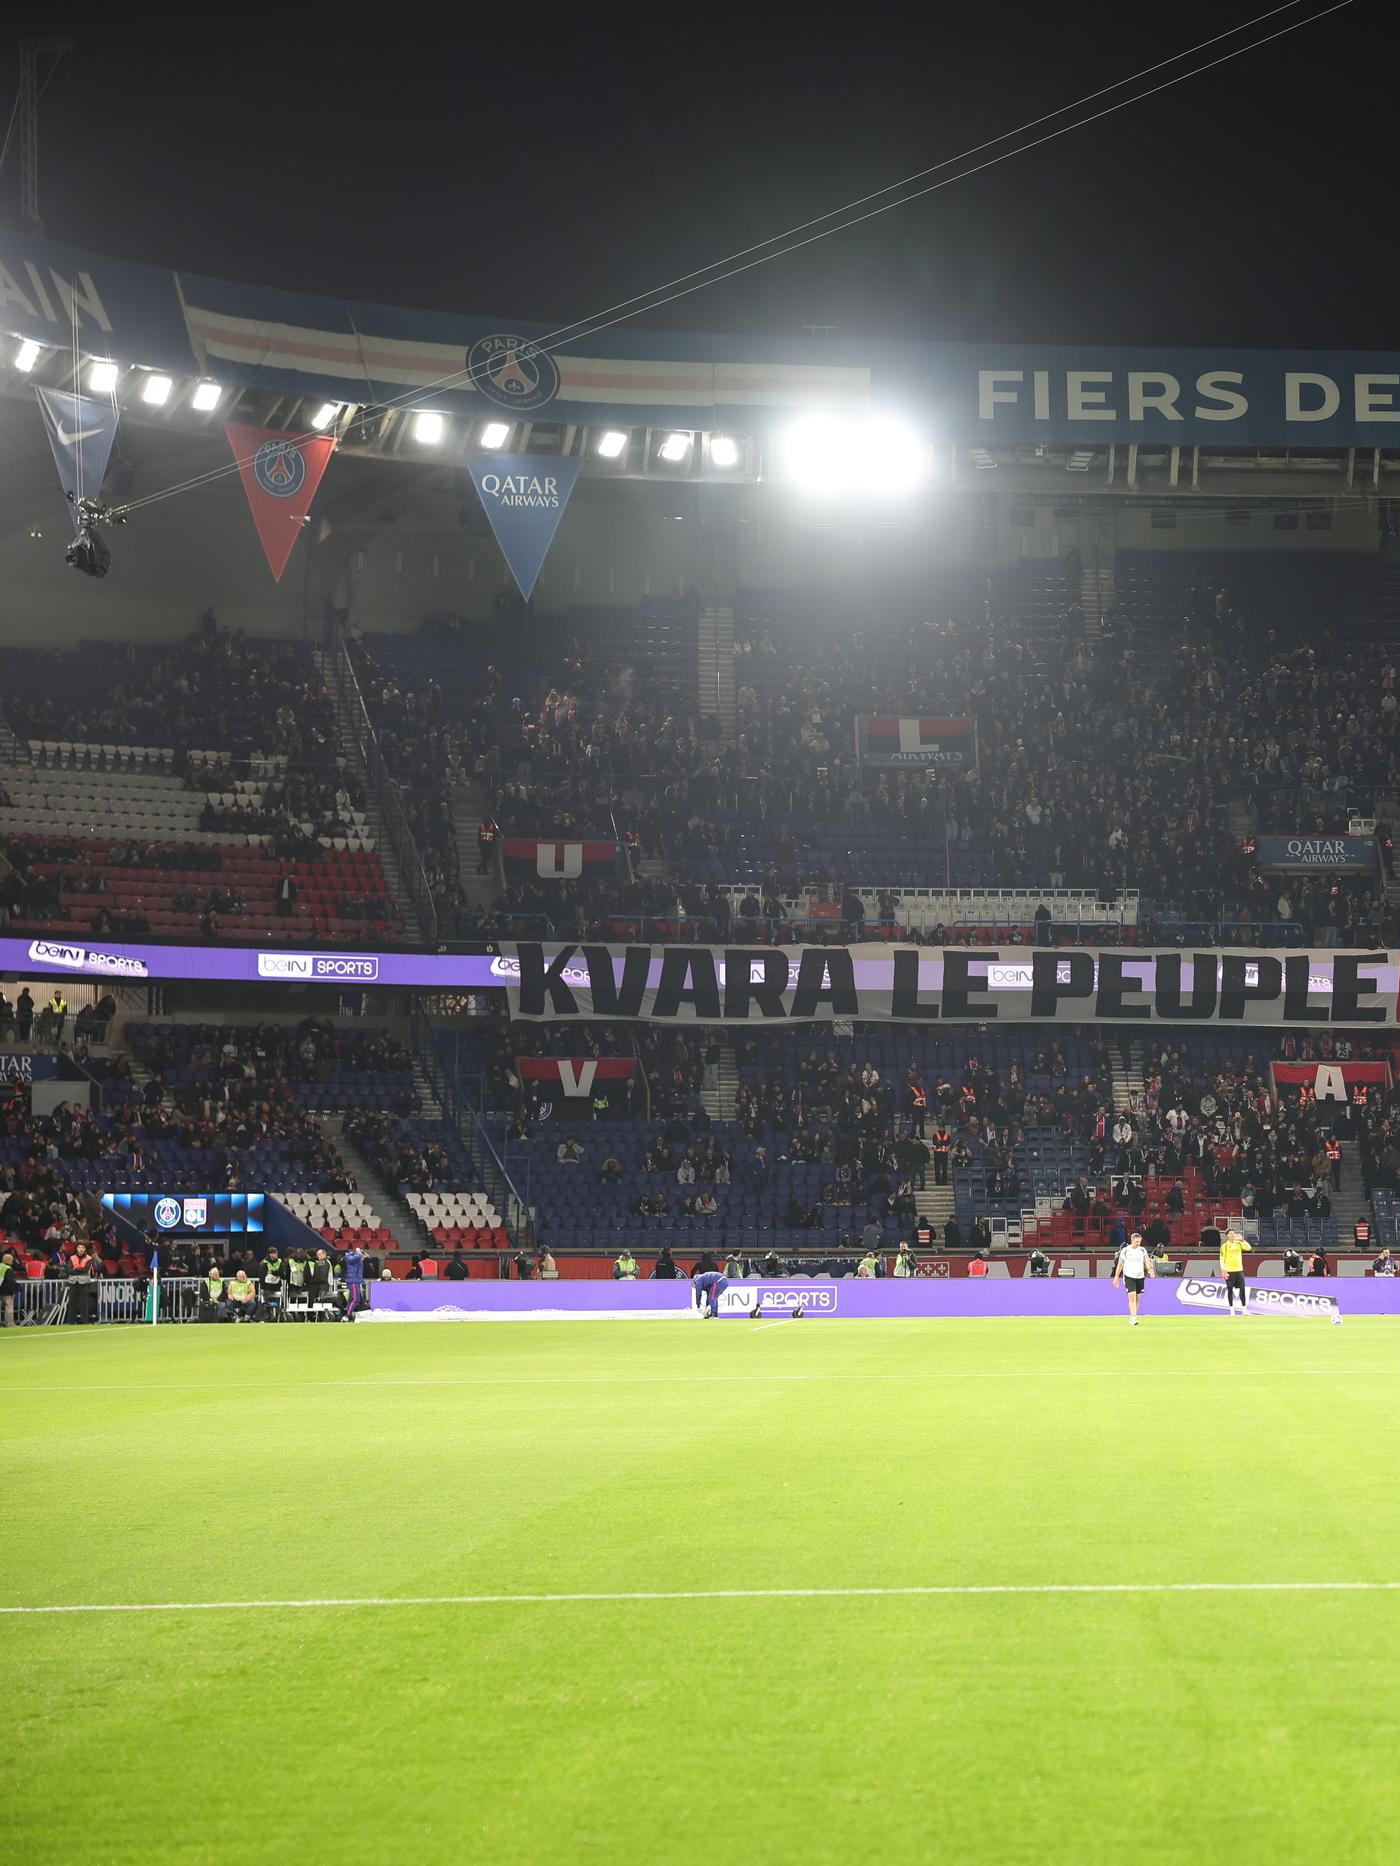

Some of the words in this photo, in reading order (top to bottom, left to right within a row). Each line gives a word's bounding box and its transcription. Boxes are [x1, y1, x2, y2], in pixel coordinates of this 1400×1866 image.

[978, 371, 1249, 421] FIERS
[481, 474, 558, 496] QATAR
[501, 495, 559, 507] AIRWAYS
[899, 719, 939, 752] L
[537, 844, 583, 878] U
[1287, 841, 1345, 856] QATAR
[1301, 855, 1346, 863] AIRWAYS
[36, 940, 80, 960] beIN
[88, 952, 143, 973] SPORTS
[264, 956, 307, 972] beIN
[317, 960, 373, 975] SPORTS
[516, 943, 859, 1018] KVARA
[891, 949, 999, 1018] LE
[1031, 951, 1388, 1022] PEUPLE
[557, 1060, 598, 1097] V
[1314, 1065, 1348, 1101] A
[762, 1290, 831, 1307] SPORTS
[1255, 1290, 1332, 1312] SPORTS
